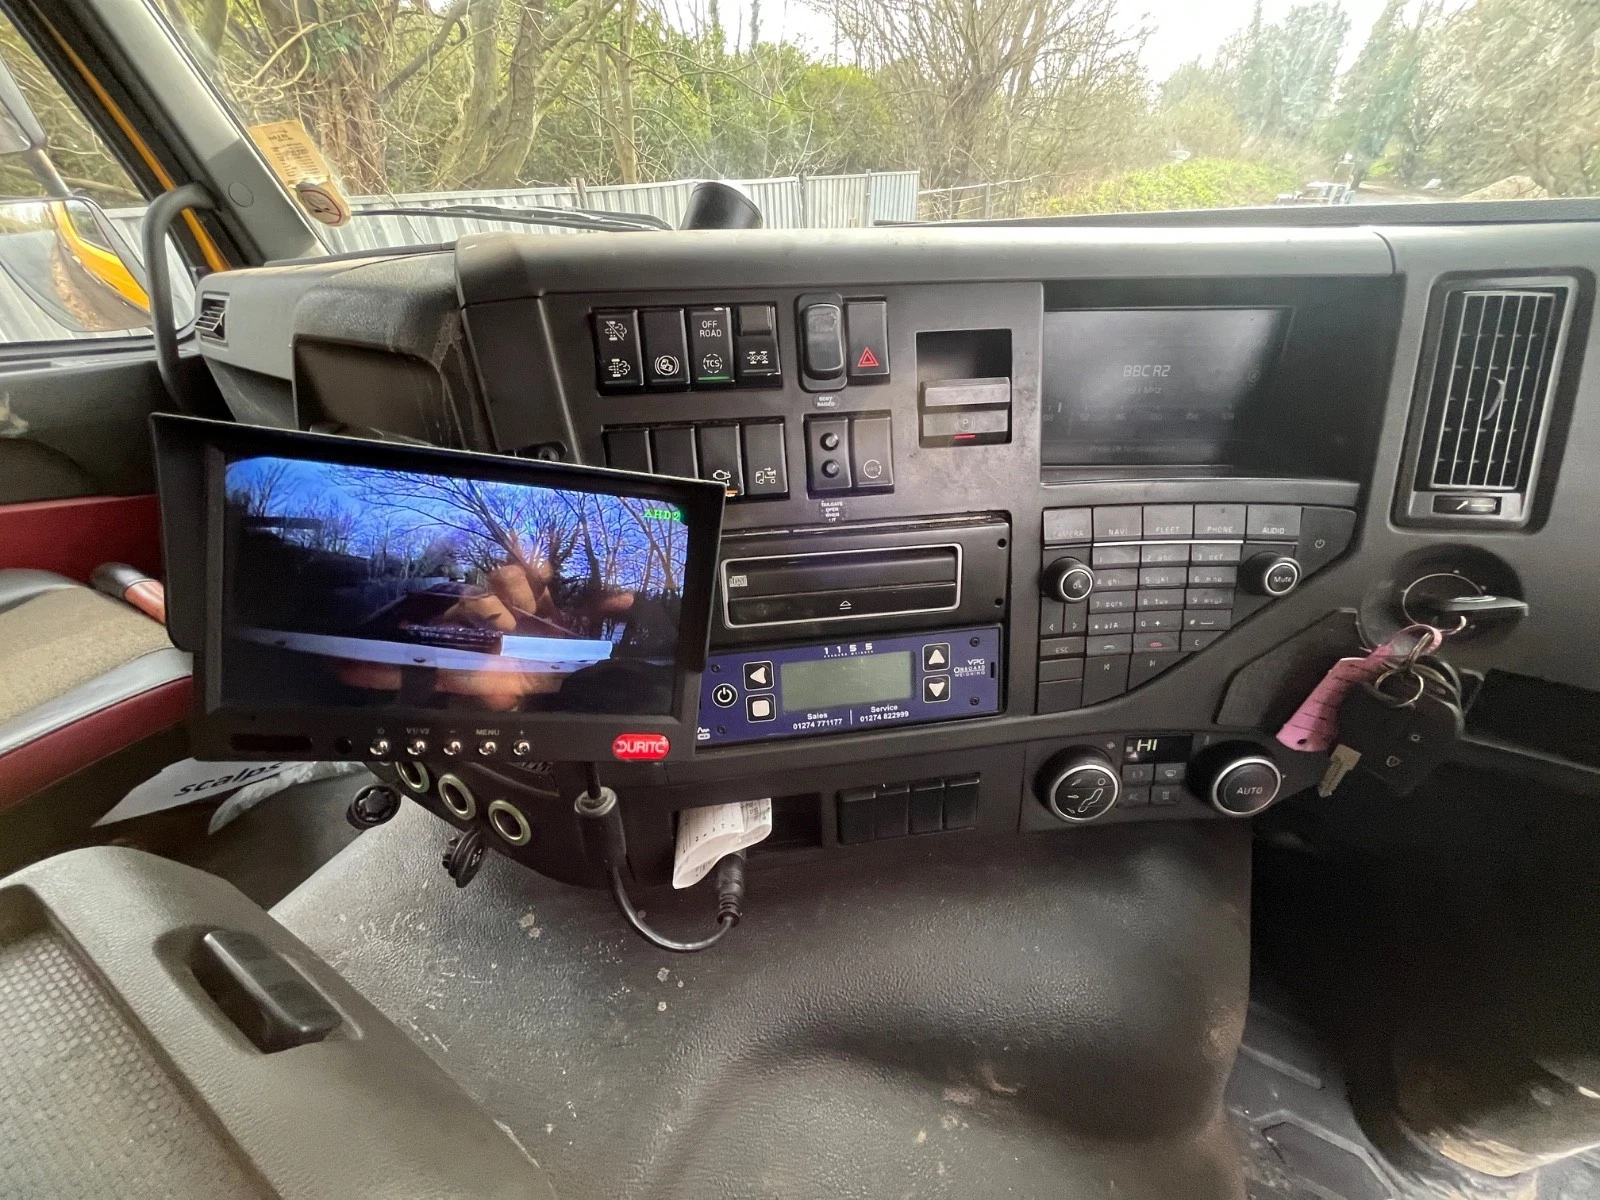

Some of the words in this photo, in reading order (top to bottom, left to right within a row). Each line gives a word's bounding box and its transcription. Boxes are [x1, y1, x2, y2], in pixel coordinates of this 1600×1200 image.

[702, 320, 718, 328] OFF
[700, 329, 722, 337] ROAD
[705, 359, 720, 368] TCS
[1123, 364, 1151, 377] BBC
[1153, 364, 1171, 377] R2
[643, 508, 681, 521] AHD2
[1108, 527, 1129, 536] NAVI
[1207, 526, 1233, 534] PHONE
[1261, 526, 1285, 535] AUDIO
[967, 658, 985, 666] VPG
[870, 704, 898, 713] Service
[807, 712, 828, 720] Sales
[859, 714, 881, 723] 01274
[883, 710, 909, 720] 822999
[792, 720, 815, 730] 01274
[817, 718, 843, 728] 771177
[475, 728, 500, 736] MENU
[1136, 738, 1158, 752] HI
[1236, 786, 1263, 795] AUTO
